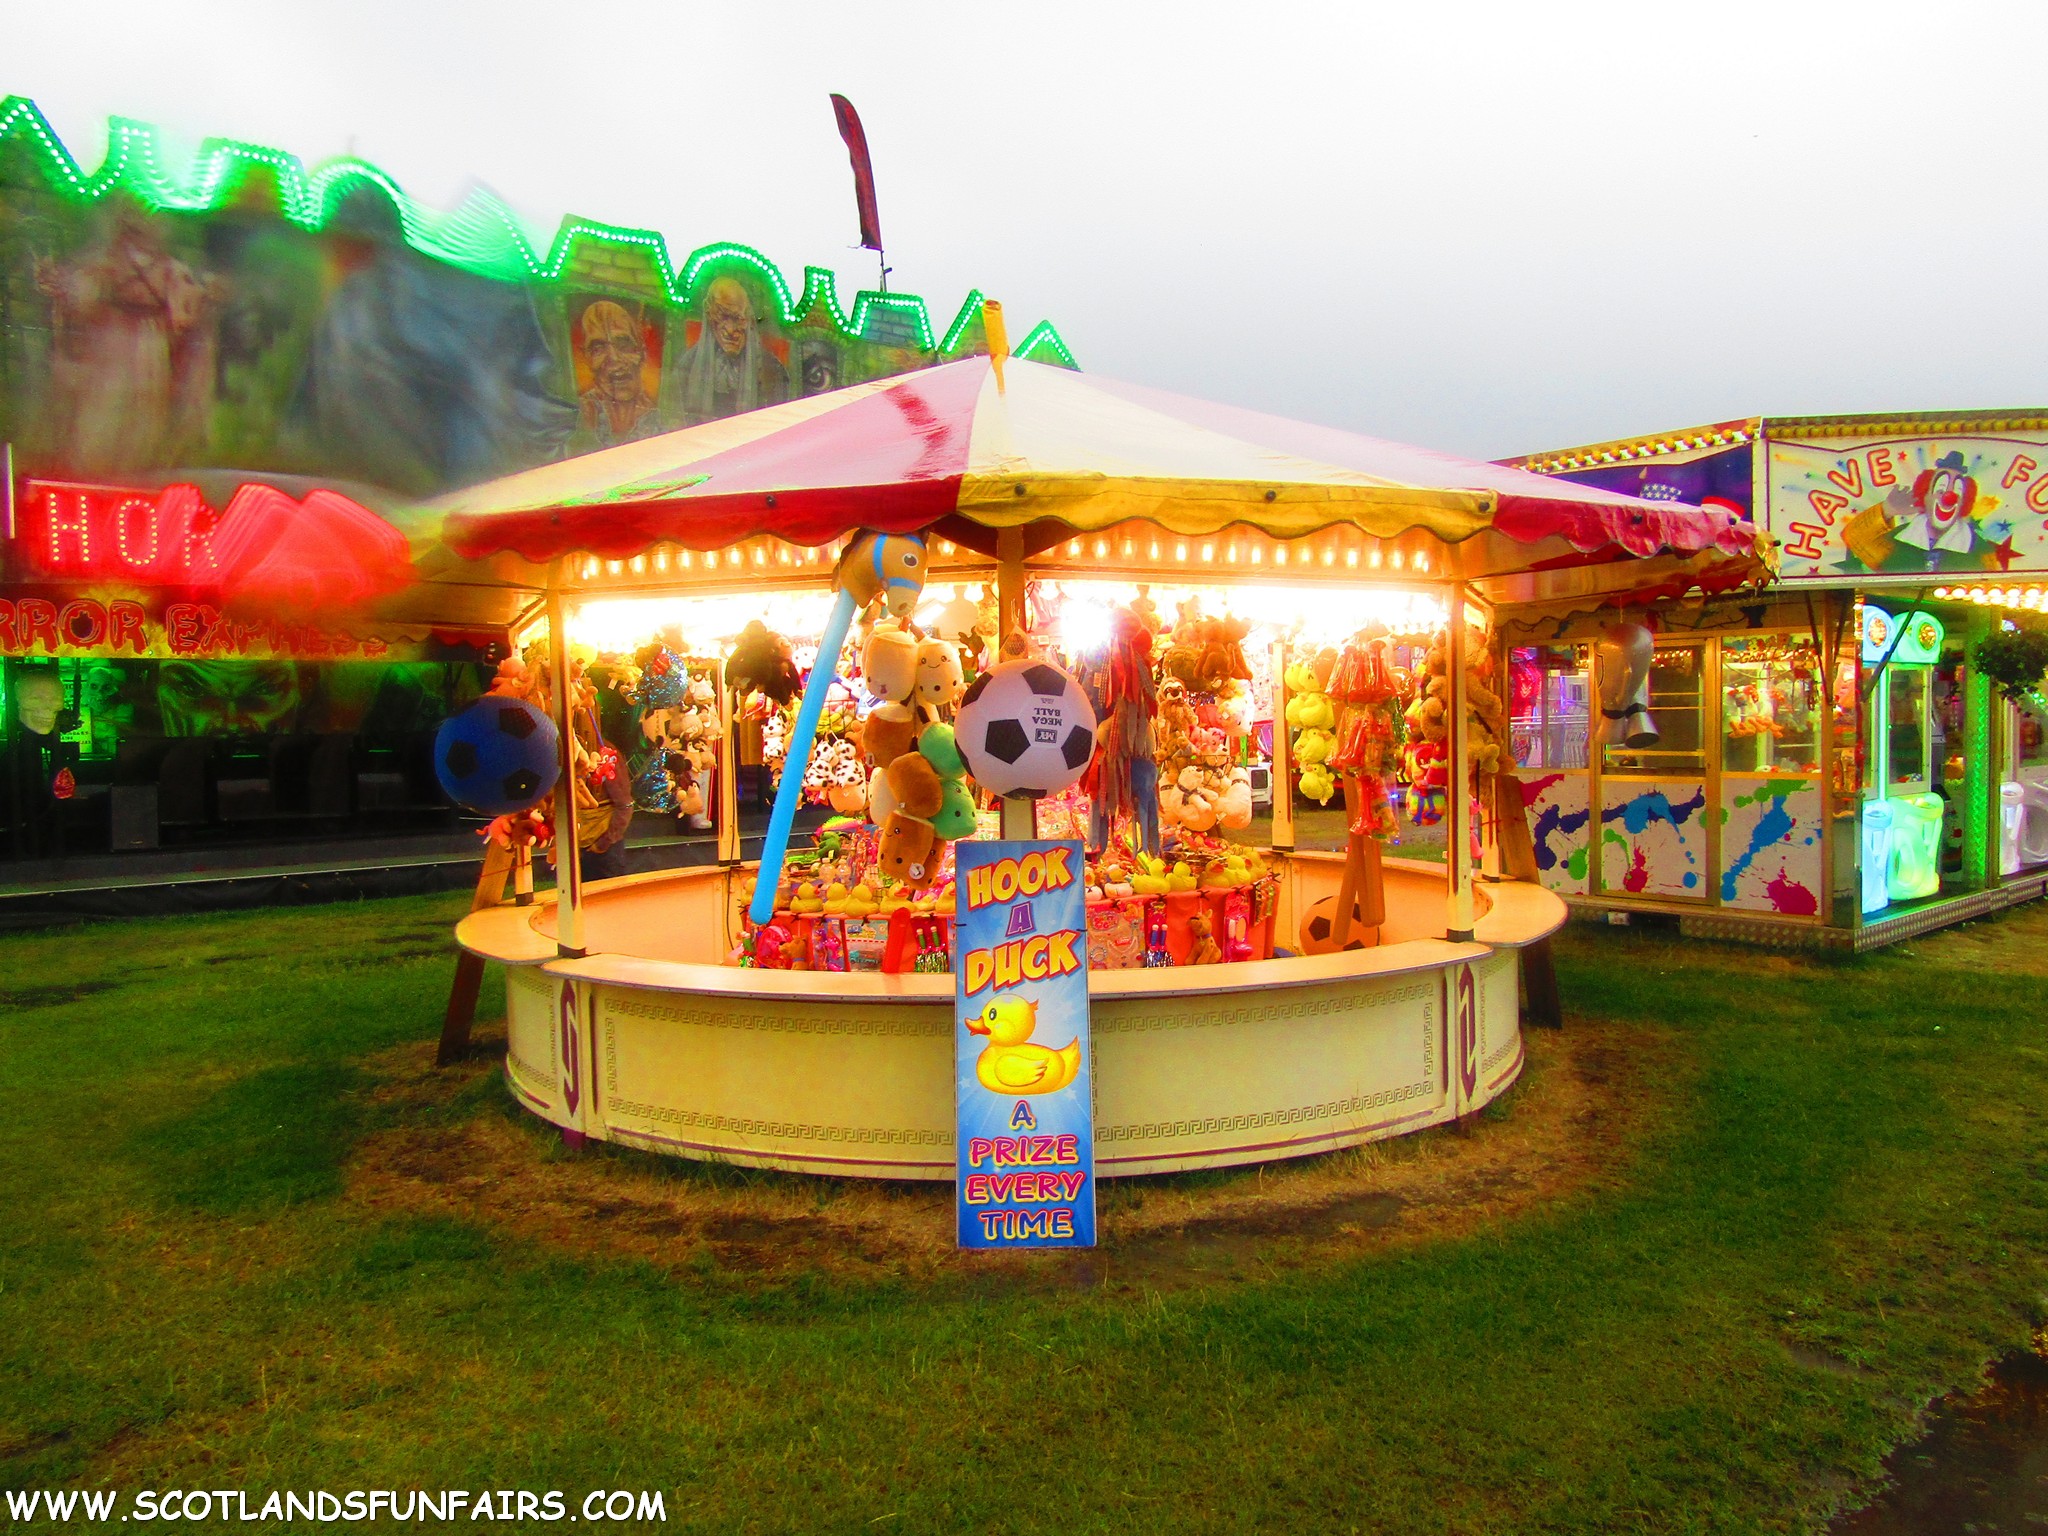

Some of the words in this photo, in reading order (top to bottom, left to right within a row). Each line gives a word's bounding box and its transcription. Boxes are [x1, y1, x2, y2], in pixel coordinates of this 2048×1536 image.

[1784, 448, 1896, 560] HAVE
[2001, 453, 2048, 531] FU
[1032, 716, 1063, 726] MEGA
[1034, 707, 1061, 717] BALL
[966, 847, 1075, 910] HOOK
[1005, 901, 1035, 937] A
[964, 929, 1081, 997] DUCK
[1009, 1100, 1036, 1130] A
[970, 1135, 1078, 1167] PRIZE
[965, 1171, 1085, 1204] EVERY
[979, 1209, 1074, 1240] TIME
